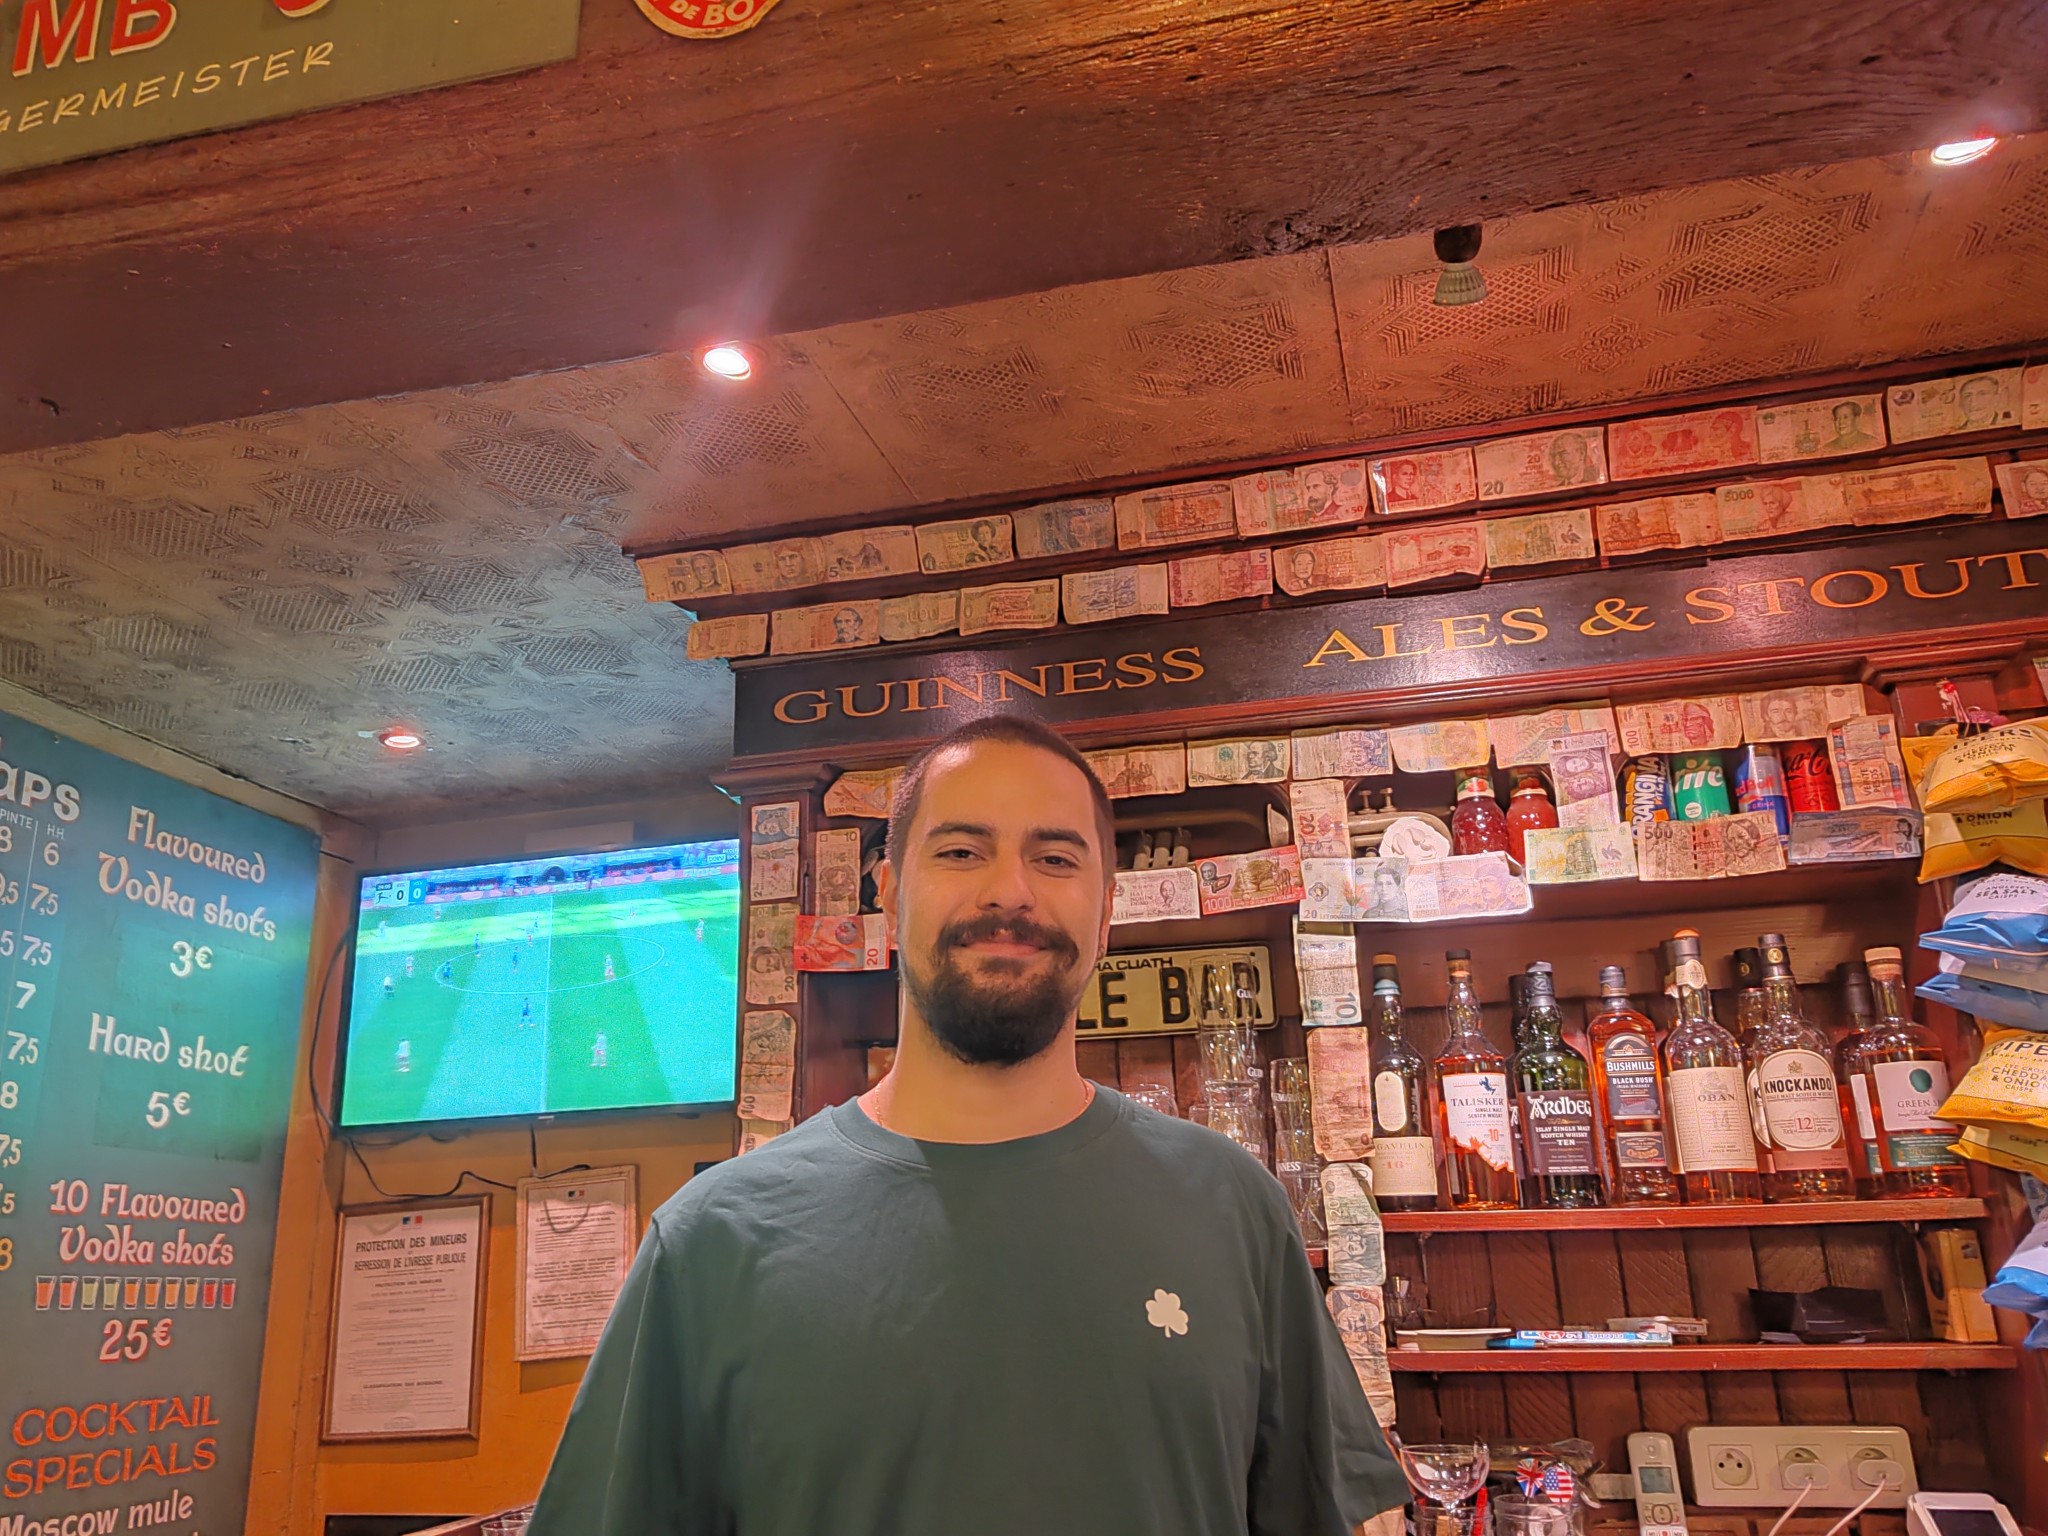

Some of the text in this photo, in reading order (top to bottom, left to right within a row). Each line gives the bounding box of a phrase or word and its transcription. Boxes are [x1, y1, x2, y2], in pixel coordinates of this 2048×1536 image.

[669, 0, 701, 20] DE
[1483, 480, 1504, 496] 20
[1259, 551, 1267, 563] 5
[772, 548, 2048, 724] GUINNESS ALES & STOUT
[1191, 775, 1204, 784] 50
[1301, 813, 1315, 835] 20
[1966, 811, 2012, 822] ONION
[844, 831, 858, 842] 10
[1644, 827, 1673, 840] 500
[44, 842, 60, 866] 6
[127, 805, 266, 884] Flavoured
[1896, 843, 1912, 854] 50
[31, 883, 58, 915] 7,5
[98, 851, 276, 941] Vodka shots
[396, 887, 422, 901] 0 0
[1204, 897, 1232, 911] 1000
[1976, 890, 1999, 898] SEA
[1304, 909, 1317, 919] 20
[22, 935, 52, 965] 7,5
[170, 940, 213, 977] 3€
[867, 947, 879, 966] 20
[784, 975, 794, 992] 20
[1160, 961, 1263, 1025] BAR
[16, 981, 36, 1009] 7
[1335, 992, 1358, 1019] 10
[7, 1031, 39, 1064] 7,5
[89, 1012, 249, 1077] Hard shot
[1606, 1061, 1655, 1072] BUSHMILLS
[0, 1081, 19, 1109] 8
[1764, 1077, 1833, 1094] KNOCKANDO
[2005, 1084, 2033, 1093] CRISPS
[741, 1095, 755, 1116] 100
[1451, 1098, 1504, 1107] TALISKER
[1697, 1094, 1735, 1102] OBAN
[146, 1091, 191, 1128] 5€
[1797, 1117, 1813, 1130] 12
[1489, 1129, 1499, 1141] 10
[50, 1179, 247, 1224] 10 Flavoured
[59, 1224, 234, 1266] Vodka shots
[356, 1233, 467, 1252] PROTECTION DES MINEURS
[393, 1257, 402, 1268] DE
[436, 1252, 466, 1264] PUBLIQUE
[99, 1318, 173, 1362] 25€
[12, 1395, 220, 1447] COCKTAIL
[3, 1437, 217, 1498] SPECIALS
[0, 1489, 193, 1536] Moscow mule
